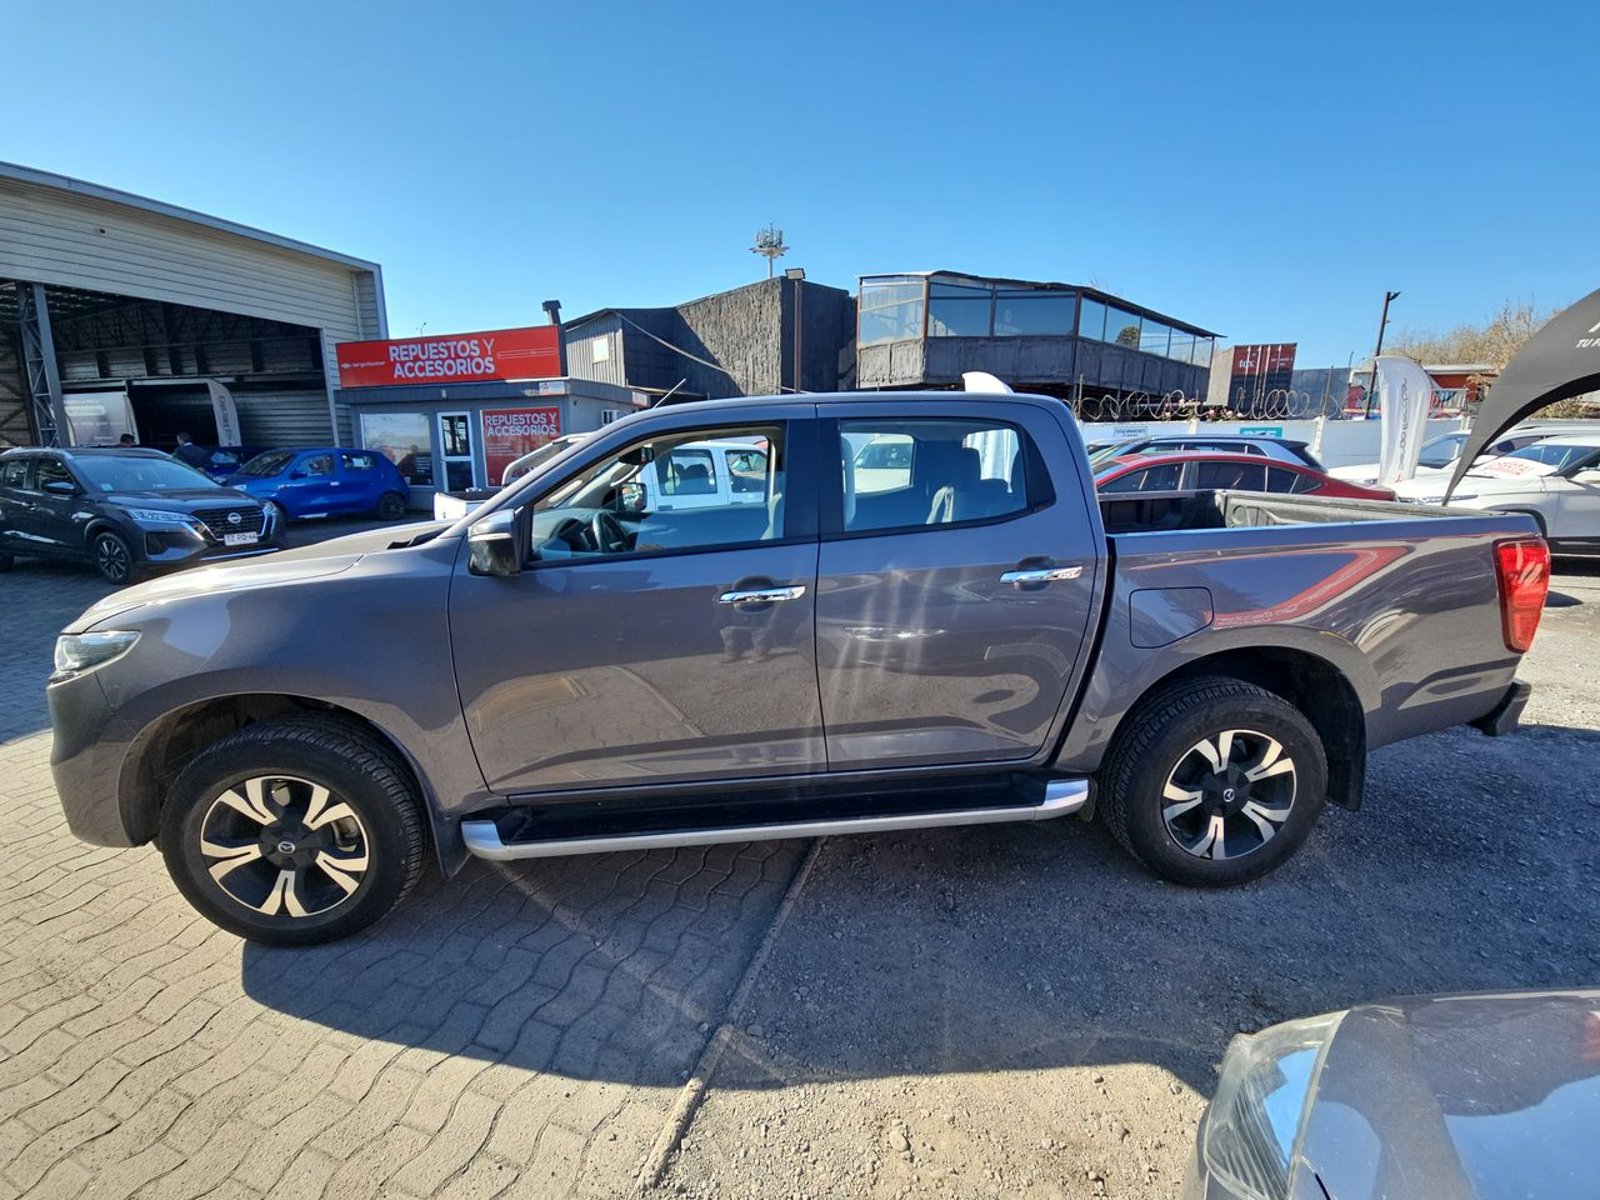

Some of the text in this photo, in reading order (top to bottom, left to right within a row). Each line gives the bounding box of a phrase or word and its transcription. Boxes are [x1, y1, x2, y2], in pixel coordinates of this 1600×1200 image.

[388, 338, 495, 361] REPUESTOS Y
[393, 357, 496, 379] ACCESORIOS
[485, 411, 558, 426] REPUESTOS Y
[487, 424, 557, 437] ACCESORIOS
